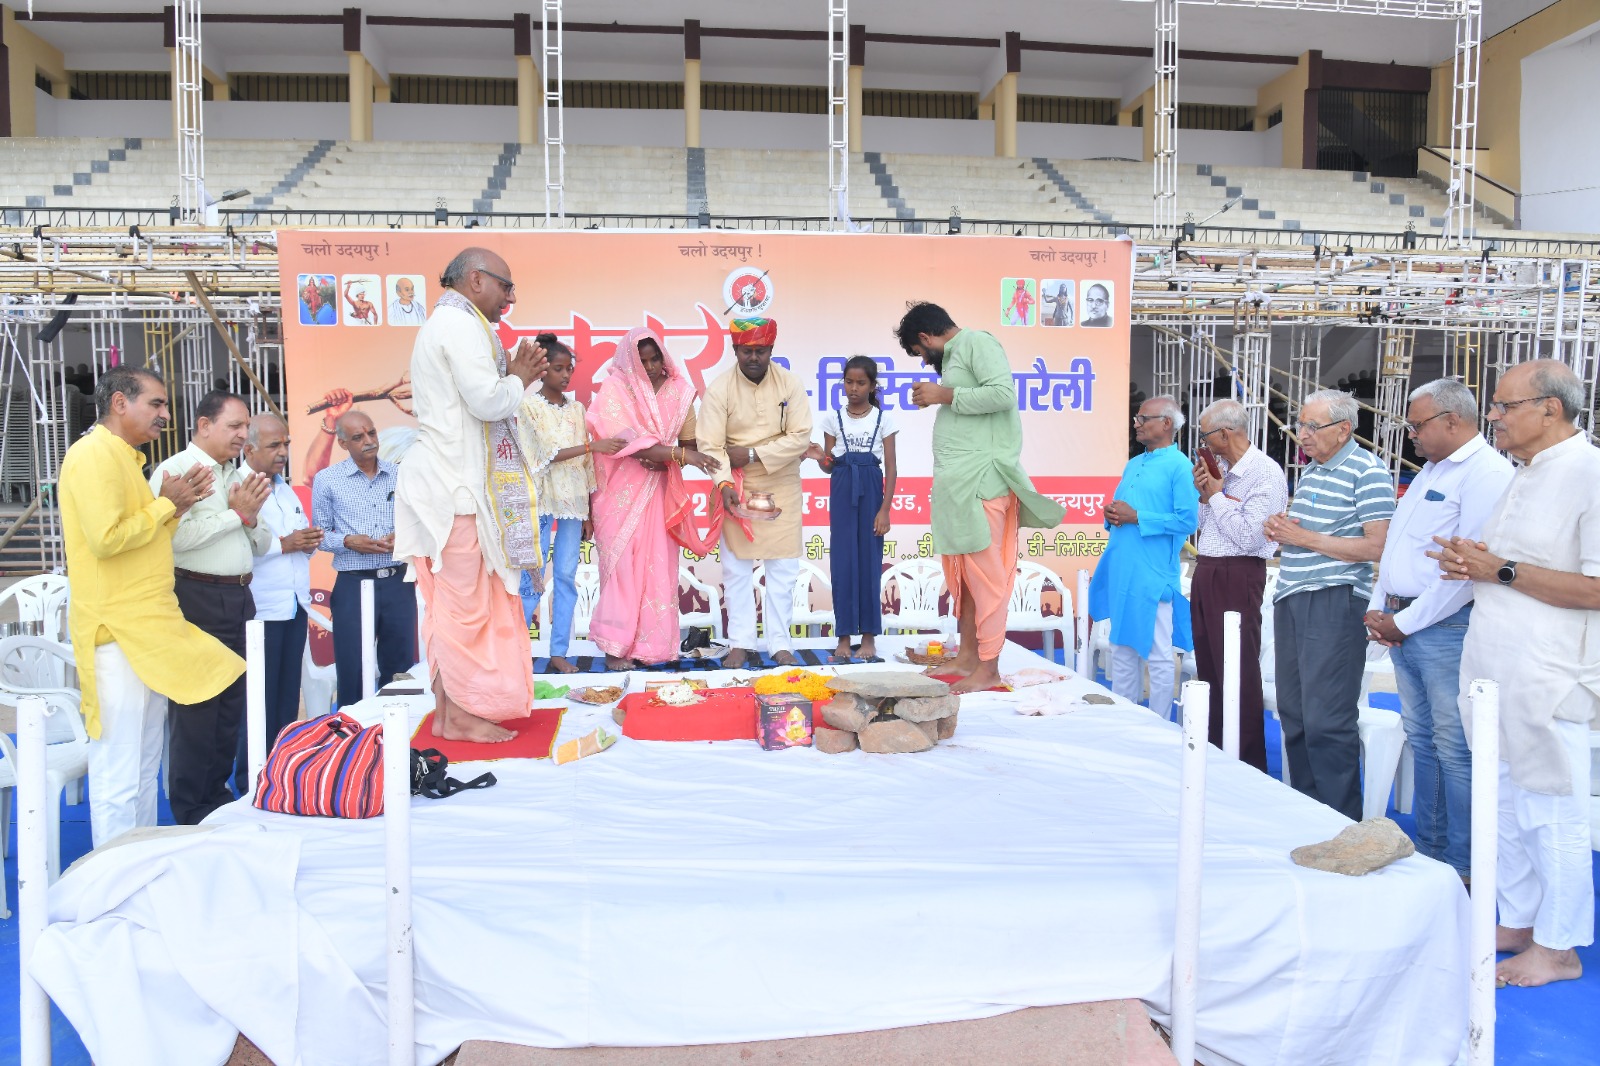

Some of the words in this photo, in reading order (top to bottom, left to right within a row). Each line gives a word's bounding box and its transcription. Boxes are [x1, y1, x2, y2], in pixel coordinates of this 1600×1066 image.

[301, 239, 332, 256] चलो
[335, 244, 379, 261] उदयपुर
[678, 241, 708, 257] चलो
[710, 245, 753, 262] उदयपुर
[1029, 246, 1057, 262] चलो
[1059, 251, 1098, 267] उदयपुर
[1041, 493, 1105, 517] दयपुर
